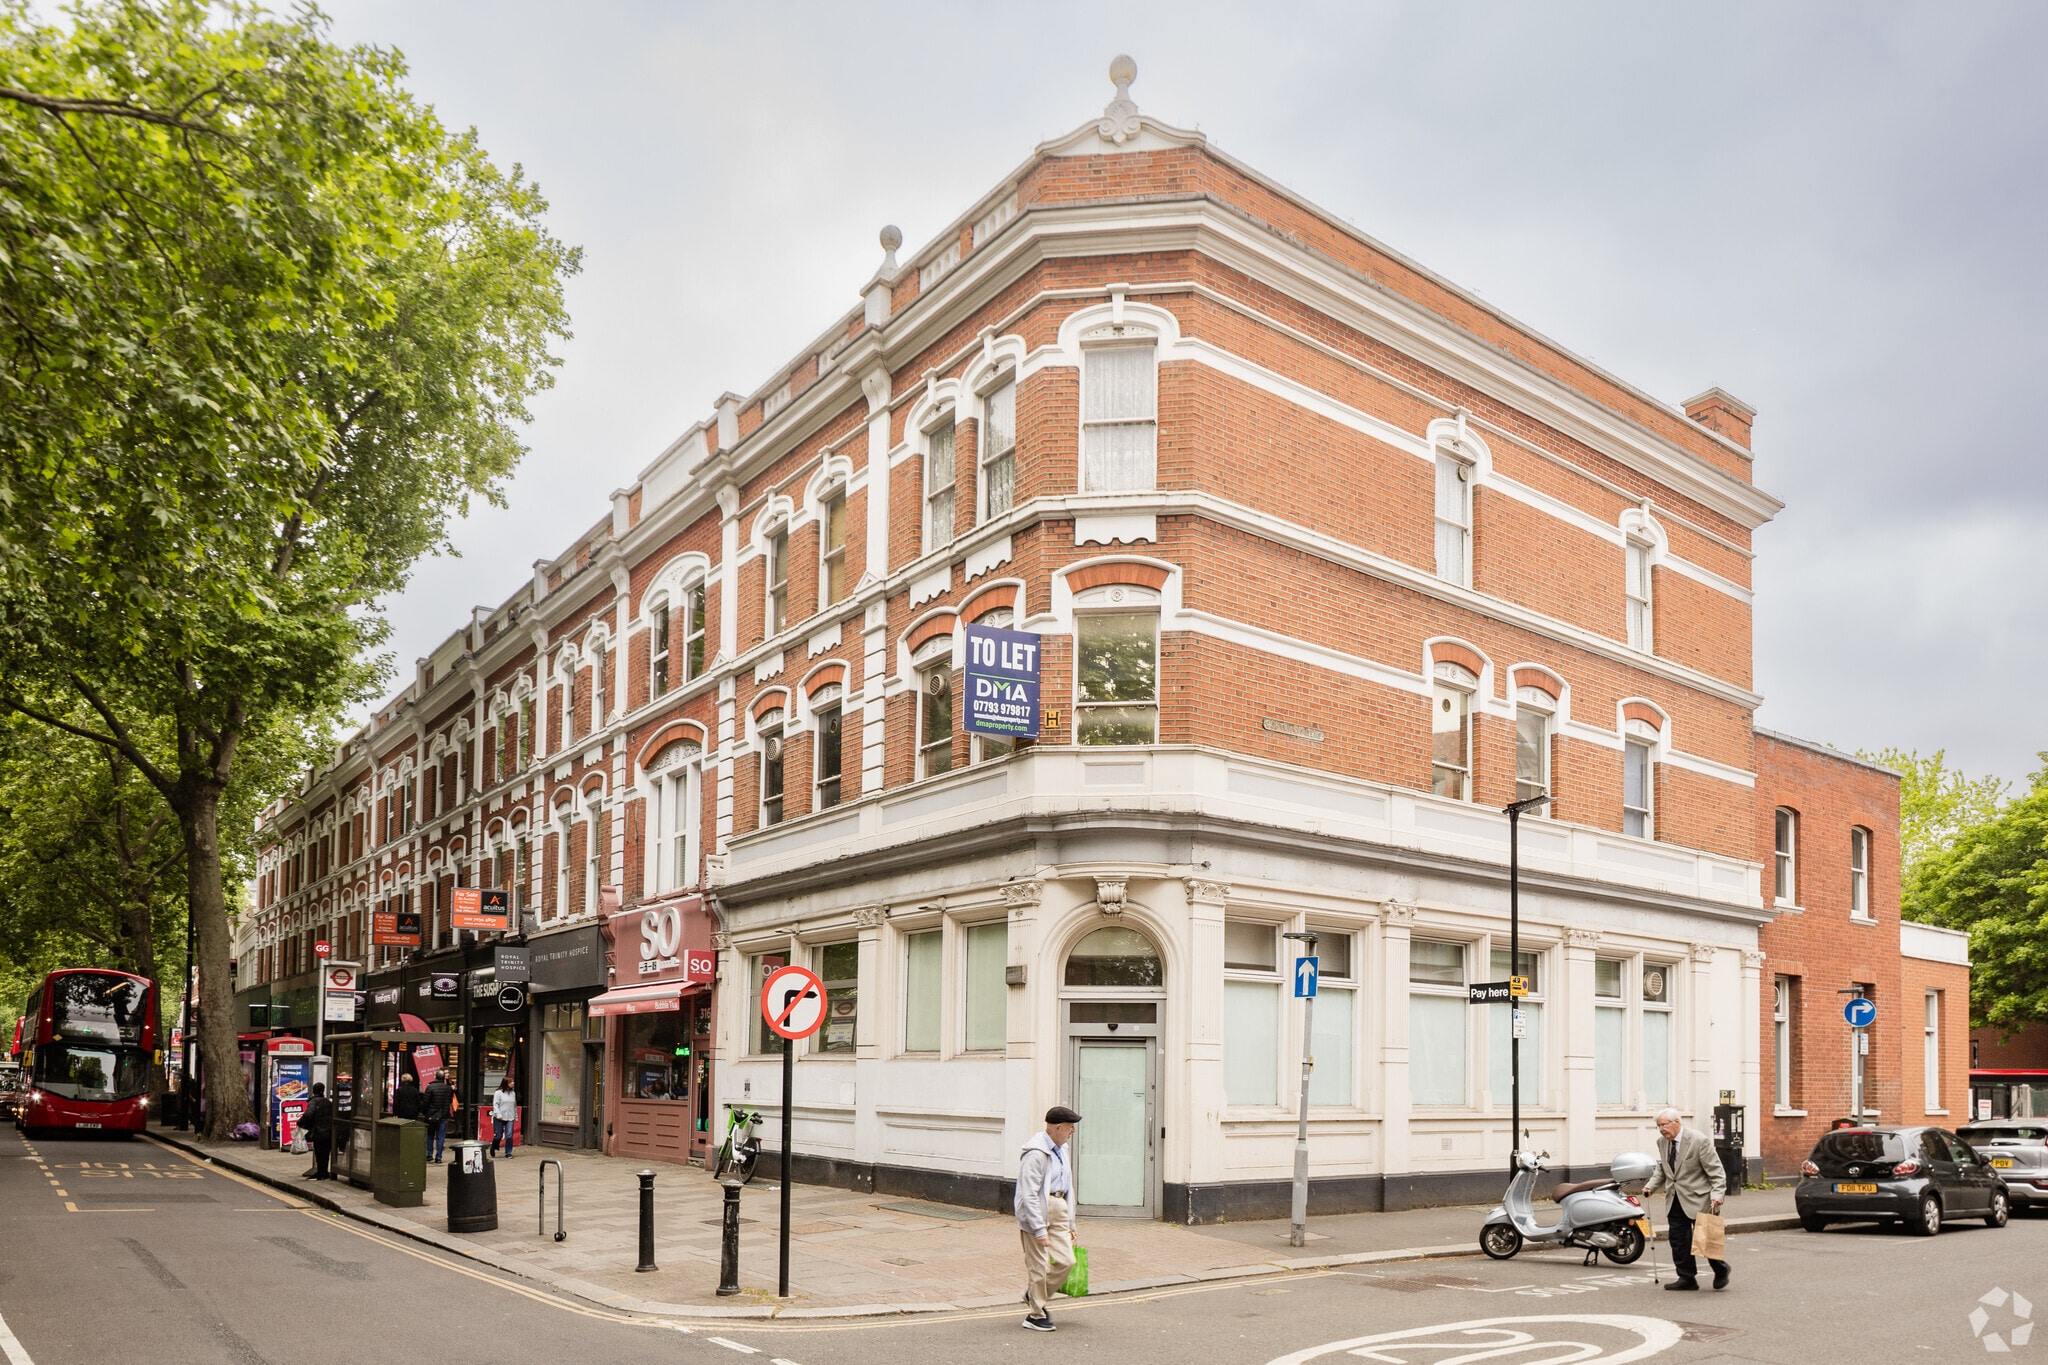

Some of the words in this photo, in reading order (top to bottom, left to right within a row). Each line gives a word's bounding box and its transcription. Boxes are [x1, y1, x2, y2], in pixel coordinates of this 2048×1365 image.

[970, 635, 996, 667] TO
[1001, 640, 1037, 672] LET
[976, 678, 1028, 703] DMA
[973, 699, 999, 715] 07793
[1000, 702, 1031, 718] 979817
[975, 719, 1028, 733] dmaproperty.com
[640, 906, 681, 961] SO
[315, 944, 330, 953] GG
[549, 950, 568, 960] TRINITY
[569, 945, 589, 957] HOSPICE
[690, 957, 712, 972] SO
[1470, 988, 1487, 1000] Pay
[1488, 987, 1509, 998] here
[654, 1001, 669, 1010] Bubble
[669, 1000, 678, 1009] Tea
[119, 1026, 135, 1039] E3
[79, 1170, 205, 1179] BUS
[1857, 1184, 1873, 1192] TKU
